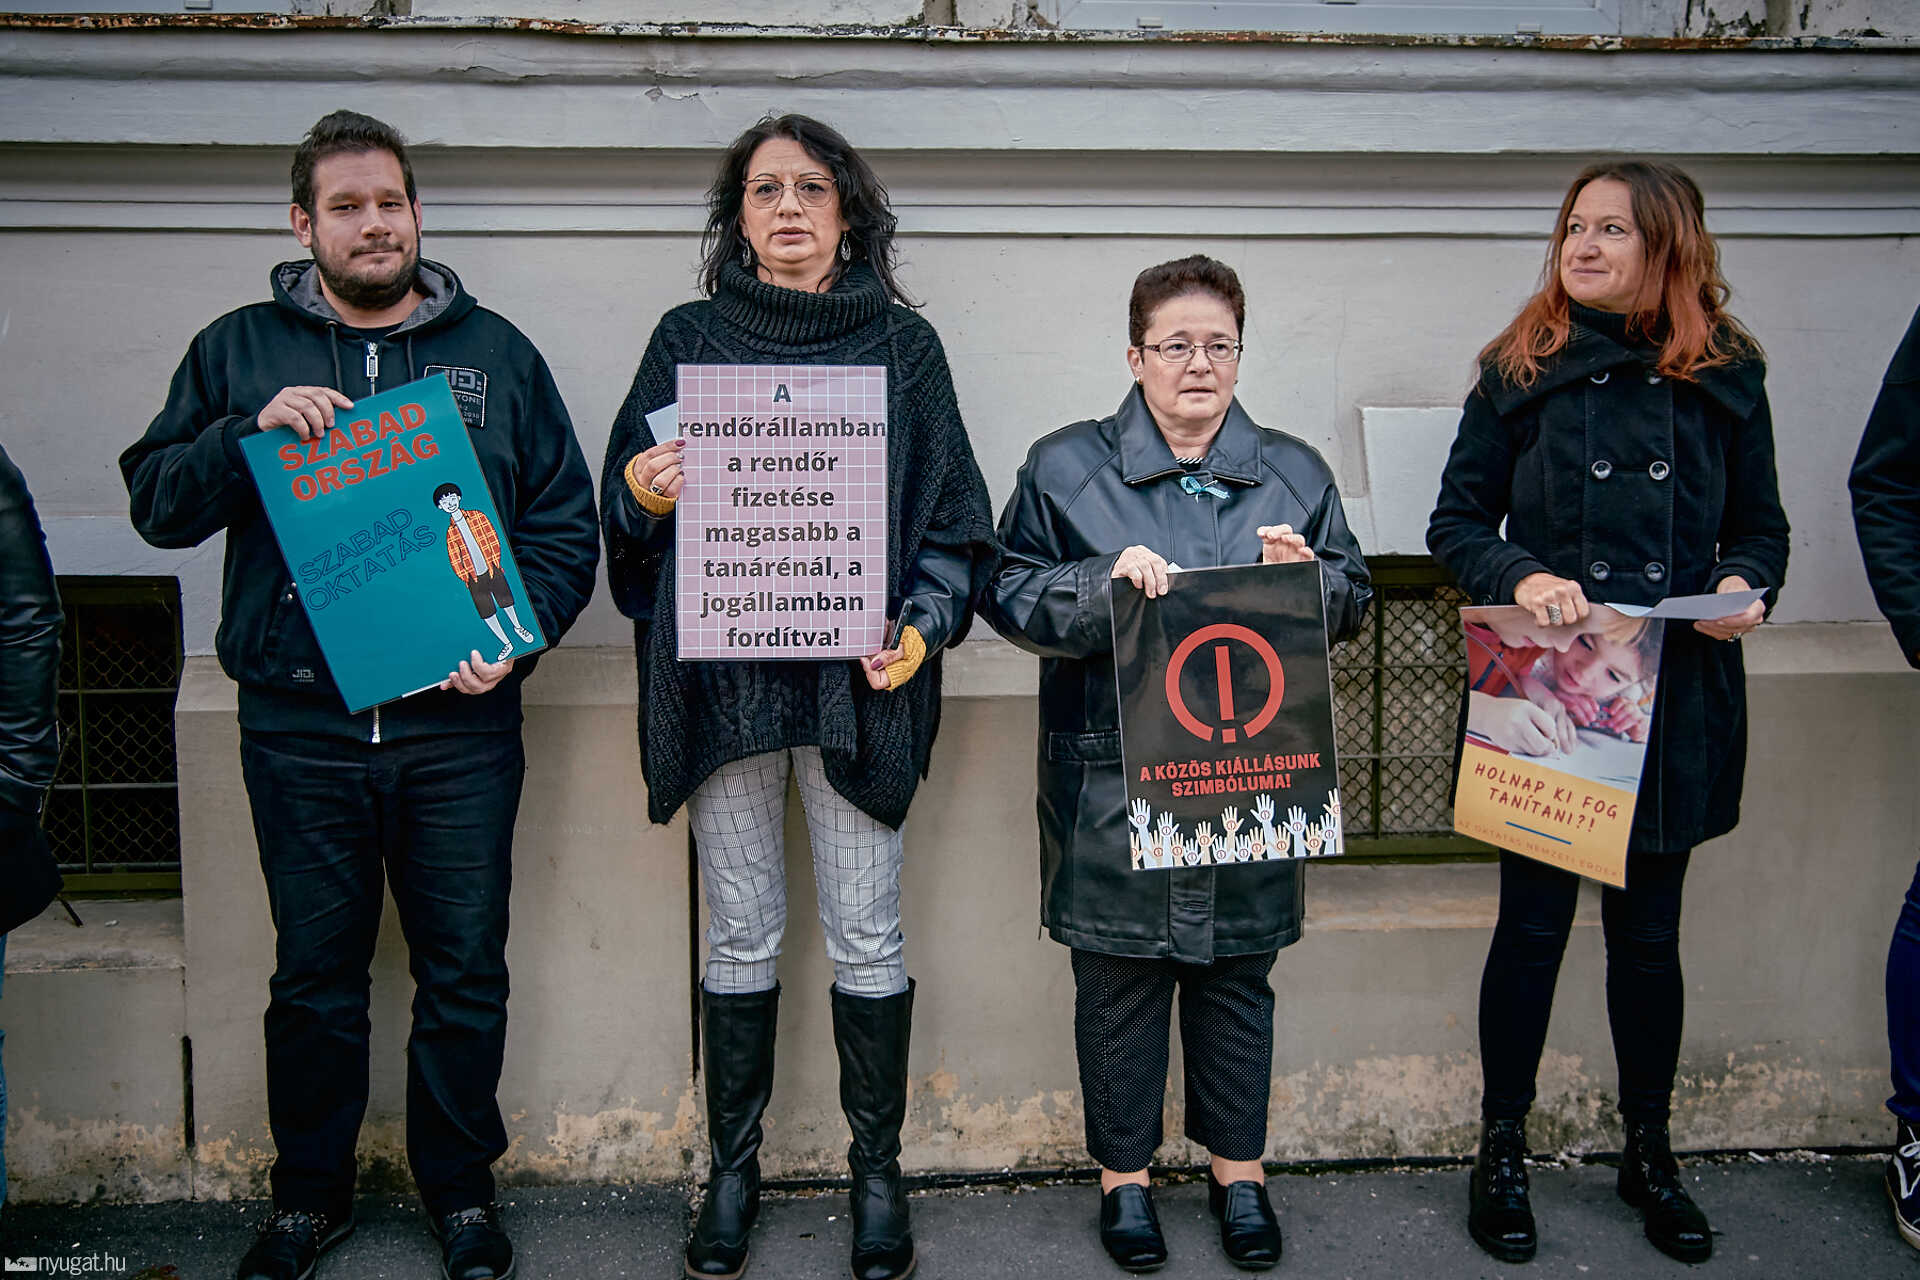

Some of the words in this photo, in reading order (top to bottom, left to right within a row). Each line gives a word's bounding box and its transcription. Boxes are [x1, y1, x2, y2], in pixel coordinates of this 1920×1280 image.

[772, 383, 792, 403] A
[278, 403, 427, 471] SZABAD
[678, 416, 886, 438] rendőrállamban
[291, 433, 441, 501] ORSZÁG
[727, 455, 742, 473] a
[750, 451, 839, 473] rendőr
[731, 486, 835, 508] fizetése
[298, 508, 413, 584] SZABAD
[705, 521, 839, 548] magasabb
[846, 525, 861, 542] a
[305, 525, 437, 611] OKTATÁS
[703, 556, 840, 580] tanárénál,
[847, 560, 862, 577] a
[700, 591, 864, 618] jogállamban
[726, 626, 840, 647] fordítva!
[1139, 766, 1152, 782] A
[1154, 760, 1212, 781] KÖZÖS
[1215, 753, 1321, 776] KIÁLLÁSUNK
[1171, 773, 1291, 797] SZIMBÓLUMA!
[1474, 762, 1545, 793] HOLNAP
[1553, 787, 1573, 804] KI
[1582, 795, 1619, 820] FOG
[1489, 787, 1596, 833] TANÍTANI?!
